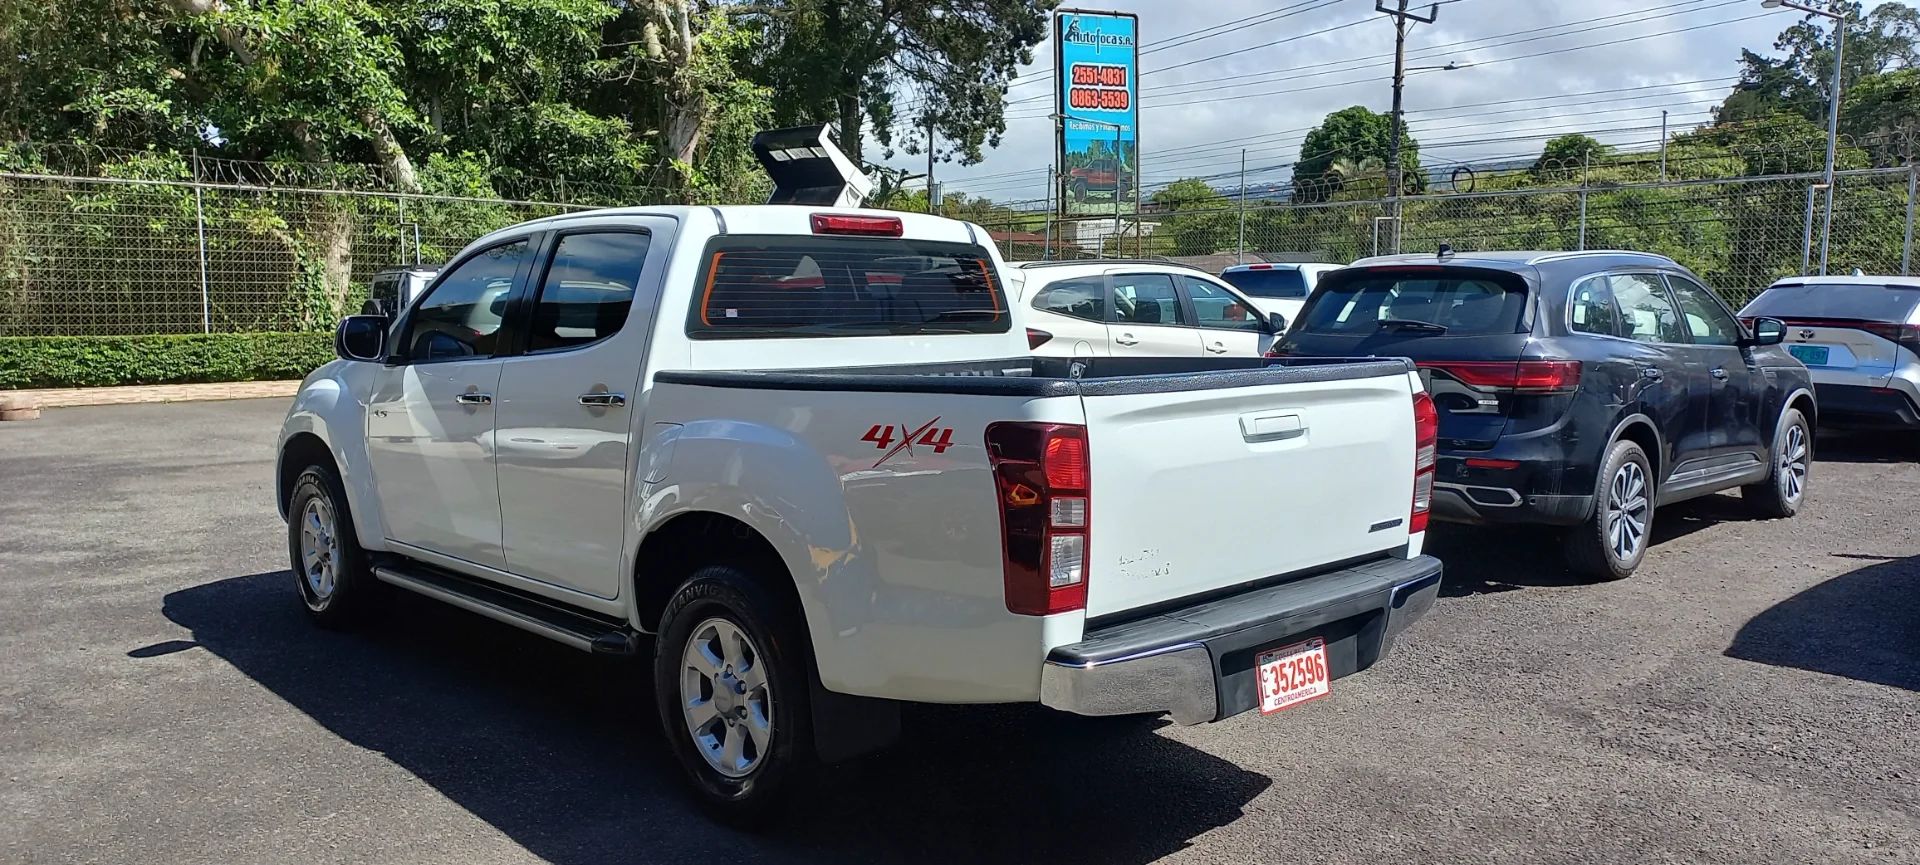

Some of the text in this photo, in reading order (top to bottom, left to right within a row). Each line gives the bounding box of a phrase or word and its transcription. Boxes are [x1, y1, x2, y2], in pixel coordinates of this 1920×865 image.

[1073, 65, 1126, 86] 2551-4831
[1071, 88, 1128, 109] 8863-5539
[1270, 653, 1324, 696] 352596
[1273, 686, 1317, 706] CENTROAMERICA
